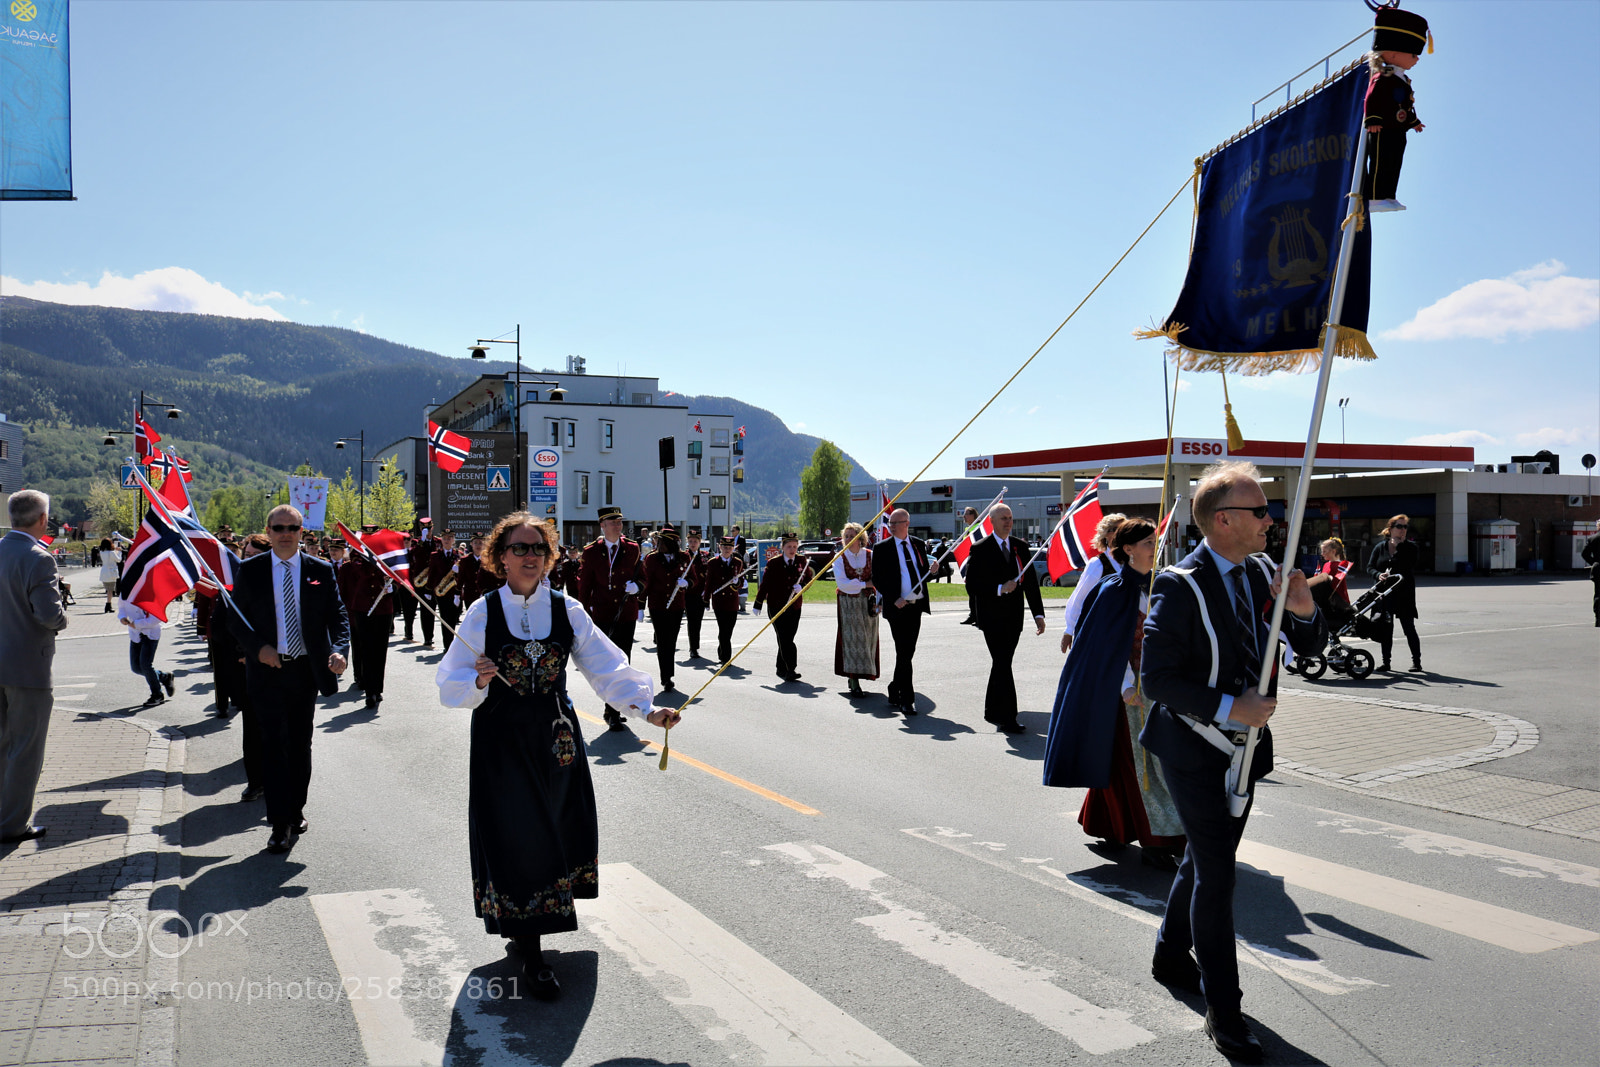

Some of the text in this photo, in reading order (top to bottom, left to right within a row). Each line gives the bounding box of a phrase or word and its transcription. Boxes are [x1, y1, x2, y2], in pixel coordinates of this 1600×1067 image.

[1219, 159, 1260, 219] MELHUS
[1181, 442, 1223, 456] ESSO
[537, 454, 556, 462] Esso
[967, 458, 990, 471] ESSO
[447, 472, 485, 480] LEGESENT
